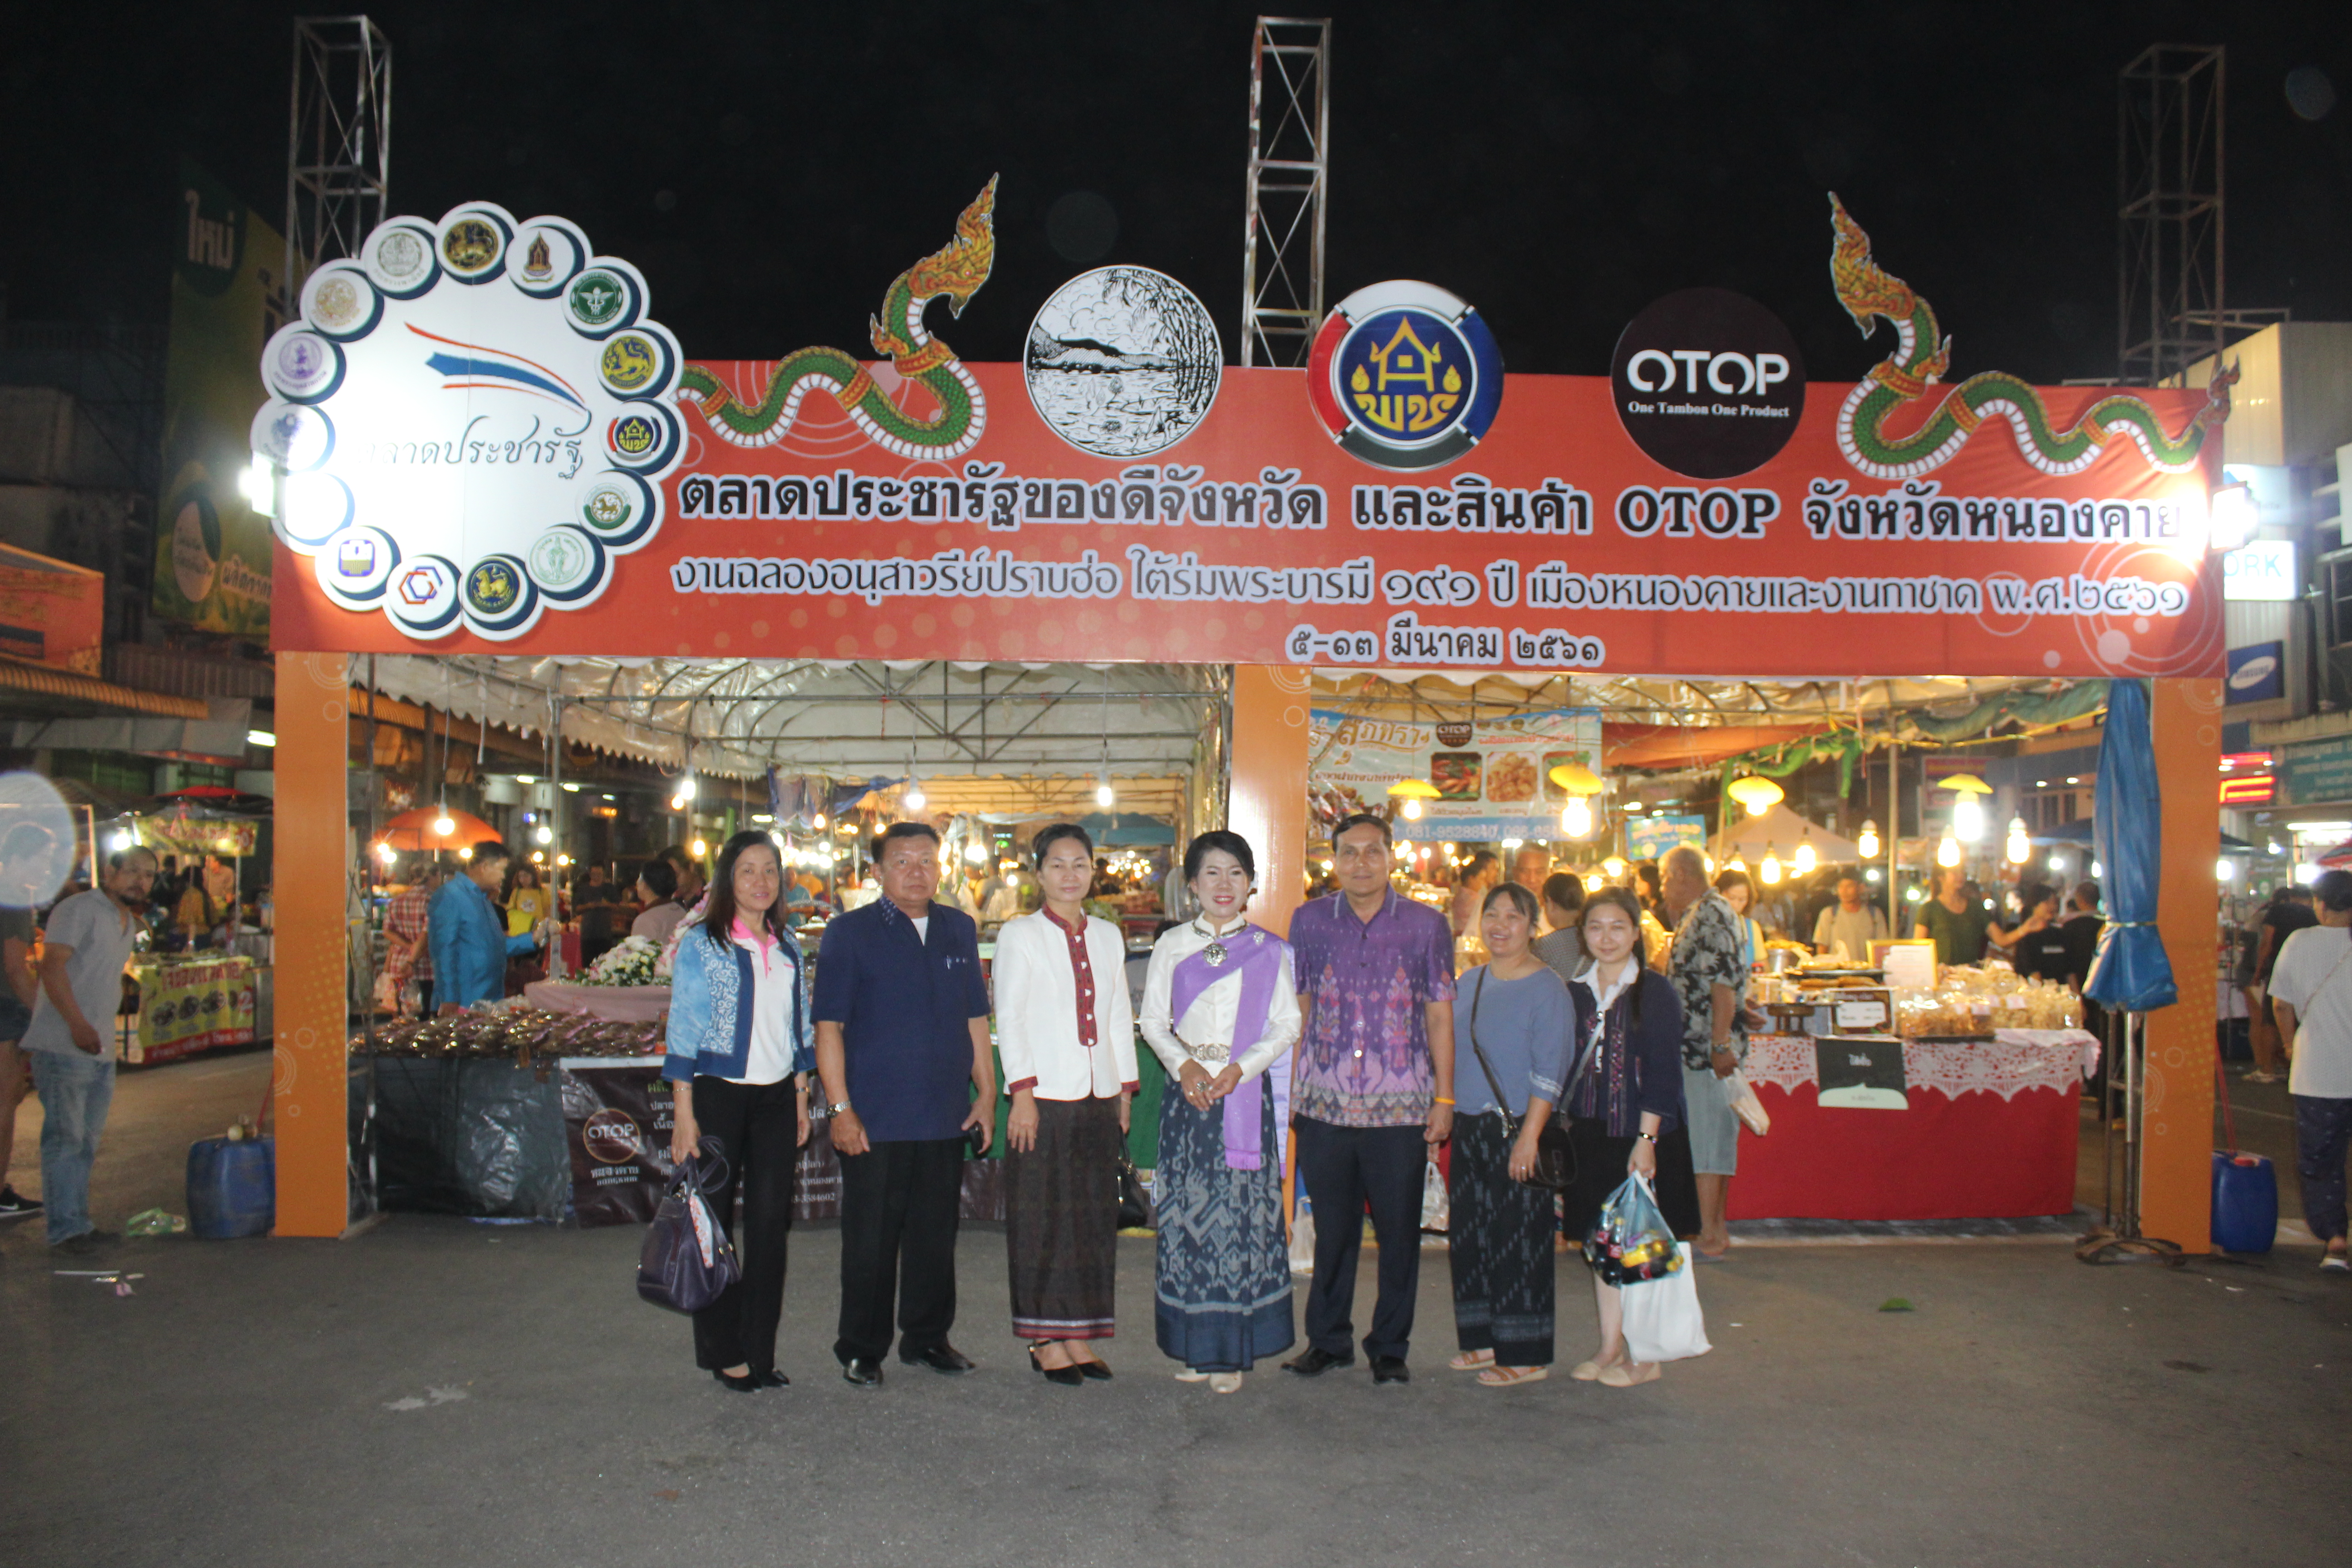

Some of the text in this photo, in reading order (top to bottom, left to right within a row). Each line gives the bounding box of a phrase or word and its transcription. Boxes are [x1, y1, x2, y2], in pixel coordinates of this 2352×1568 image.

[1627, 349, 1790, 395] OTOP
[1628, 401, 1790, 417] One Tambon One Product
[681, 465, 2180, 538] ตลาดประชารัฐของดีจังหวัด และสินค้า OTOP จังหวัดหนองคาย
[675, 550, 2184, 612] งานฉลองอนุสาวรีย์ปราบฮ่อ ใต้ร่มพระบารมี ๑๙๑ ปี เมืองหนองคายและงานกาชาด พ.ศ.๒๕๖๑
[1292, 617, 1600, 661] ๕-๑๓ มีนาคม ๒๕๖๑
[588, 1123, 634, 1139] OTOP
